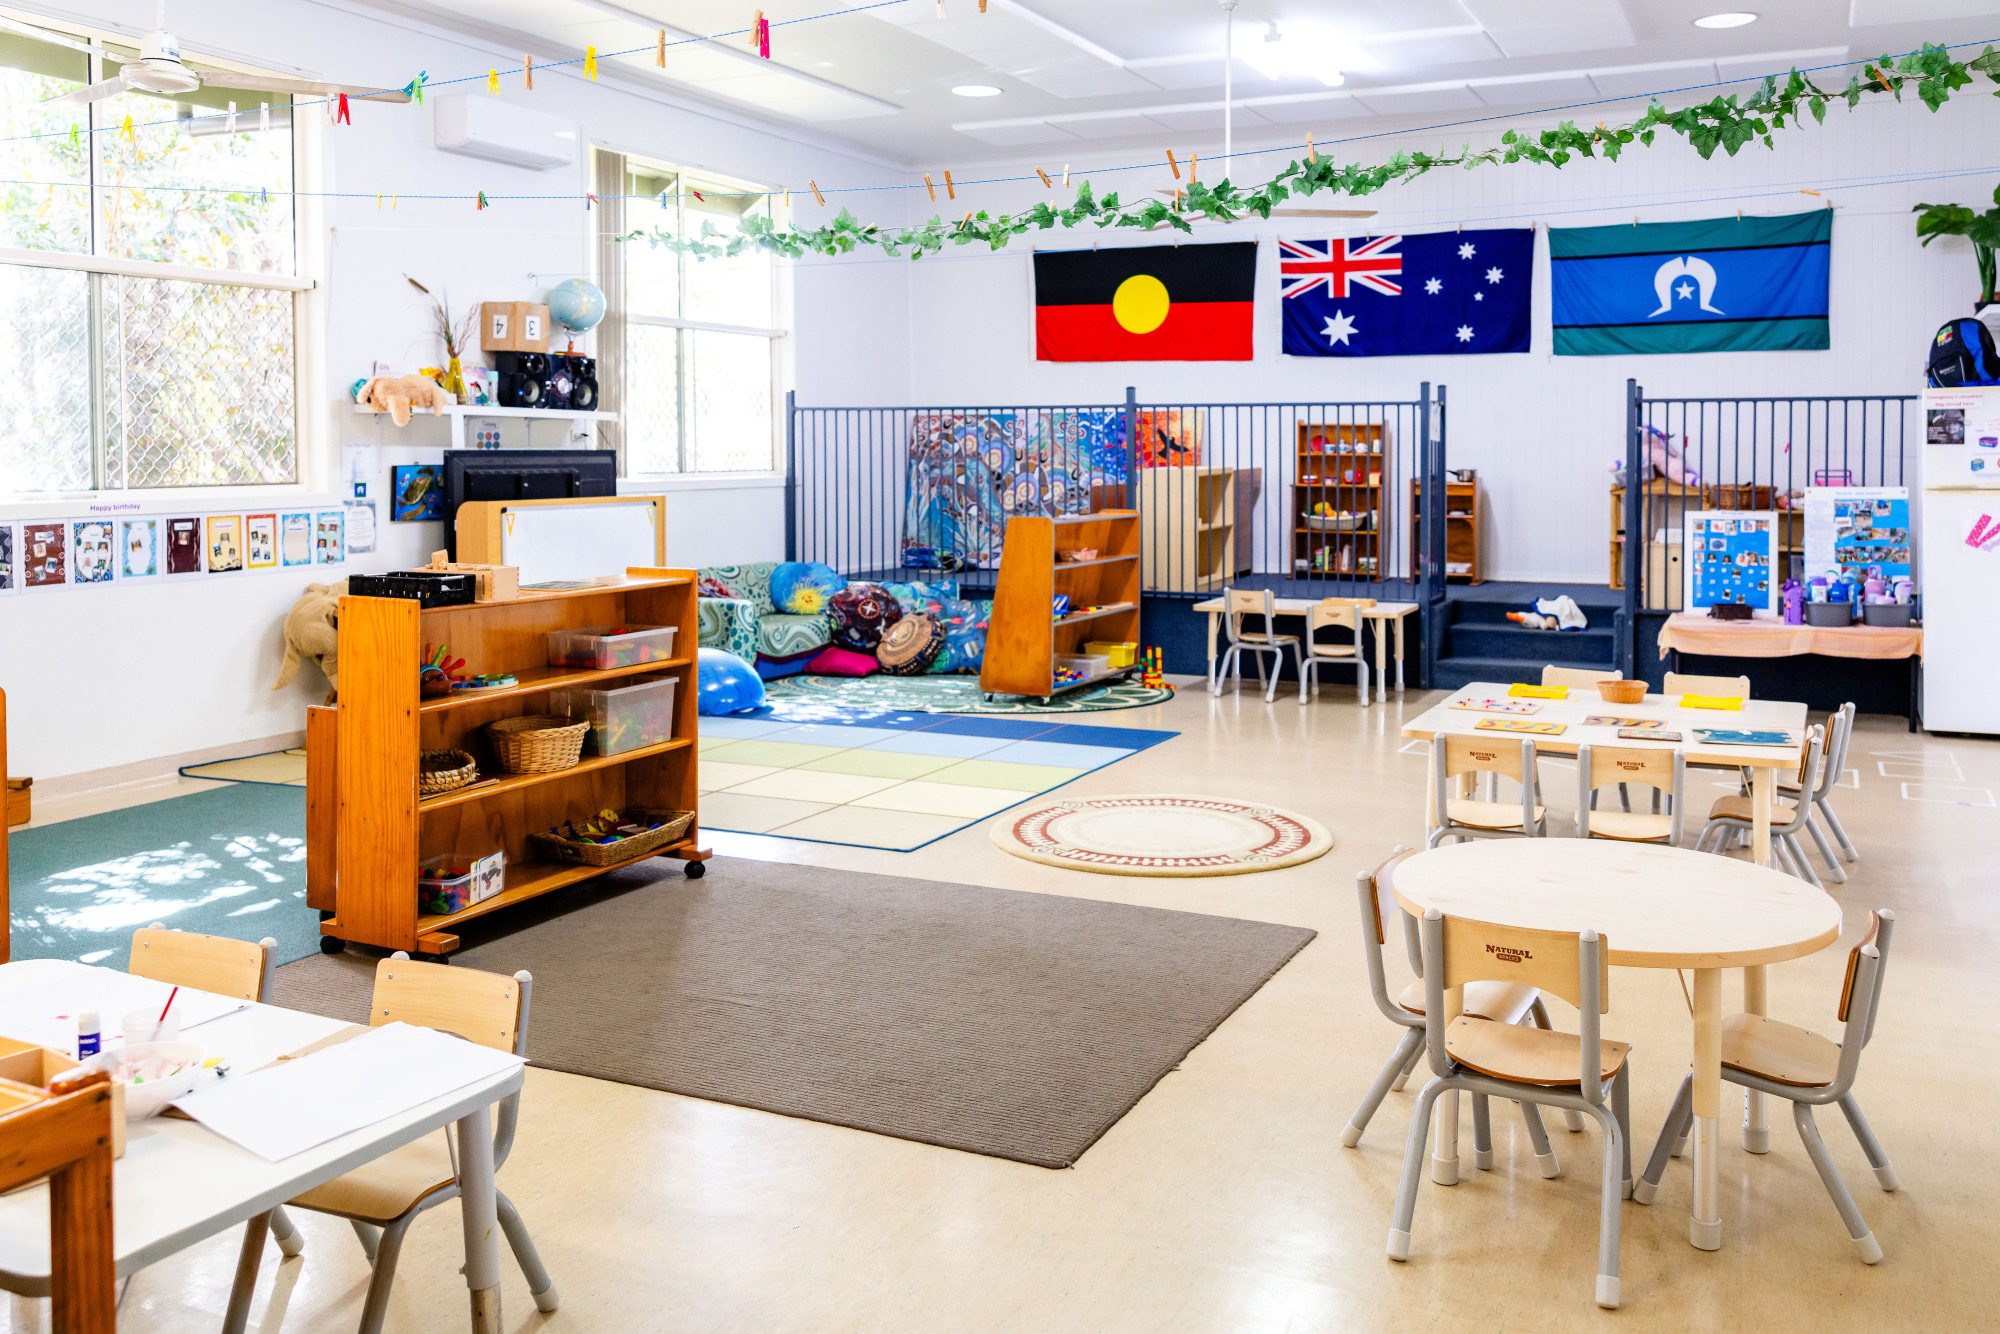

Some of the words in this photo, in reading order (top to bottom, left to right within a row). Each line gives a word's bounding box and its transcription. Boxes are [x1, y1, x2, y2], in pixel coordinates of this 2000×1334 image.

[495, 319, 504, 335] 4
[528, 320, 536, 336] 3
[113, 503, 141, 511] birthday
[1469, 751, 1498, 759] NATURAL
[1485, 944, 1533, 959] NATURAL
